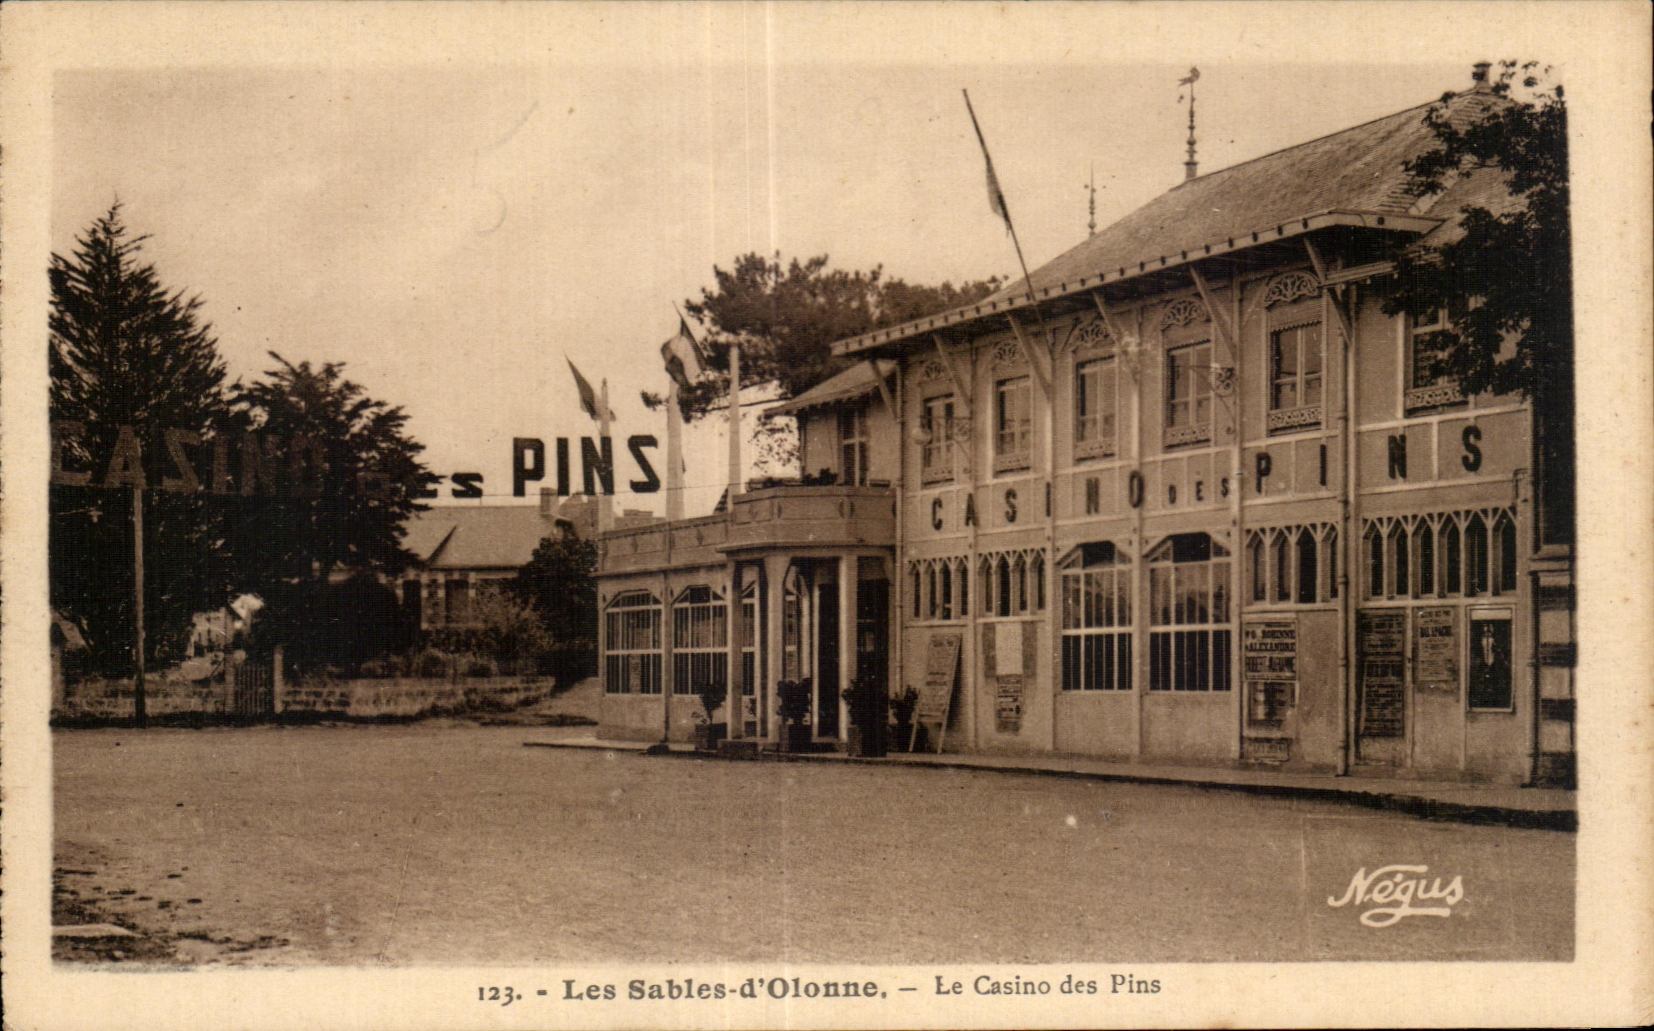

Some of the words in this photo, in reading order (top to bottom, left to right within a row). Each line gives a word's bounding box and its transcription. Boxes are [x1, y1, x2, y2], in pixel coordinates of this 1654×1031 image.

[512, 434, 660, 497] PINS
[931, 470, 1145, 531] CASINO
[1168, 477, 1230, 505] DES
[1255, 425, 1482, 494] PINS
